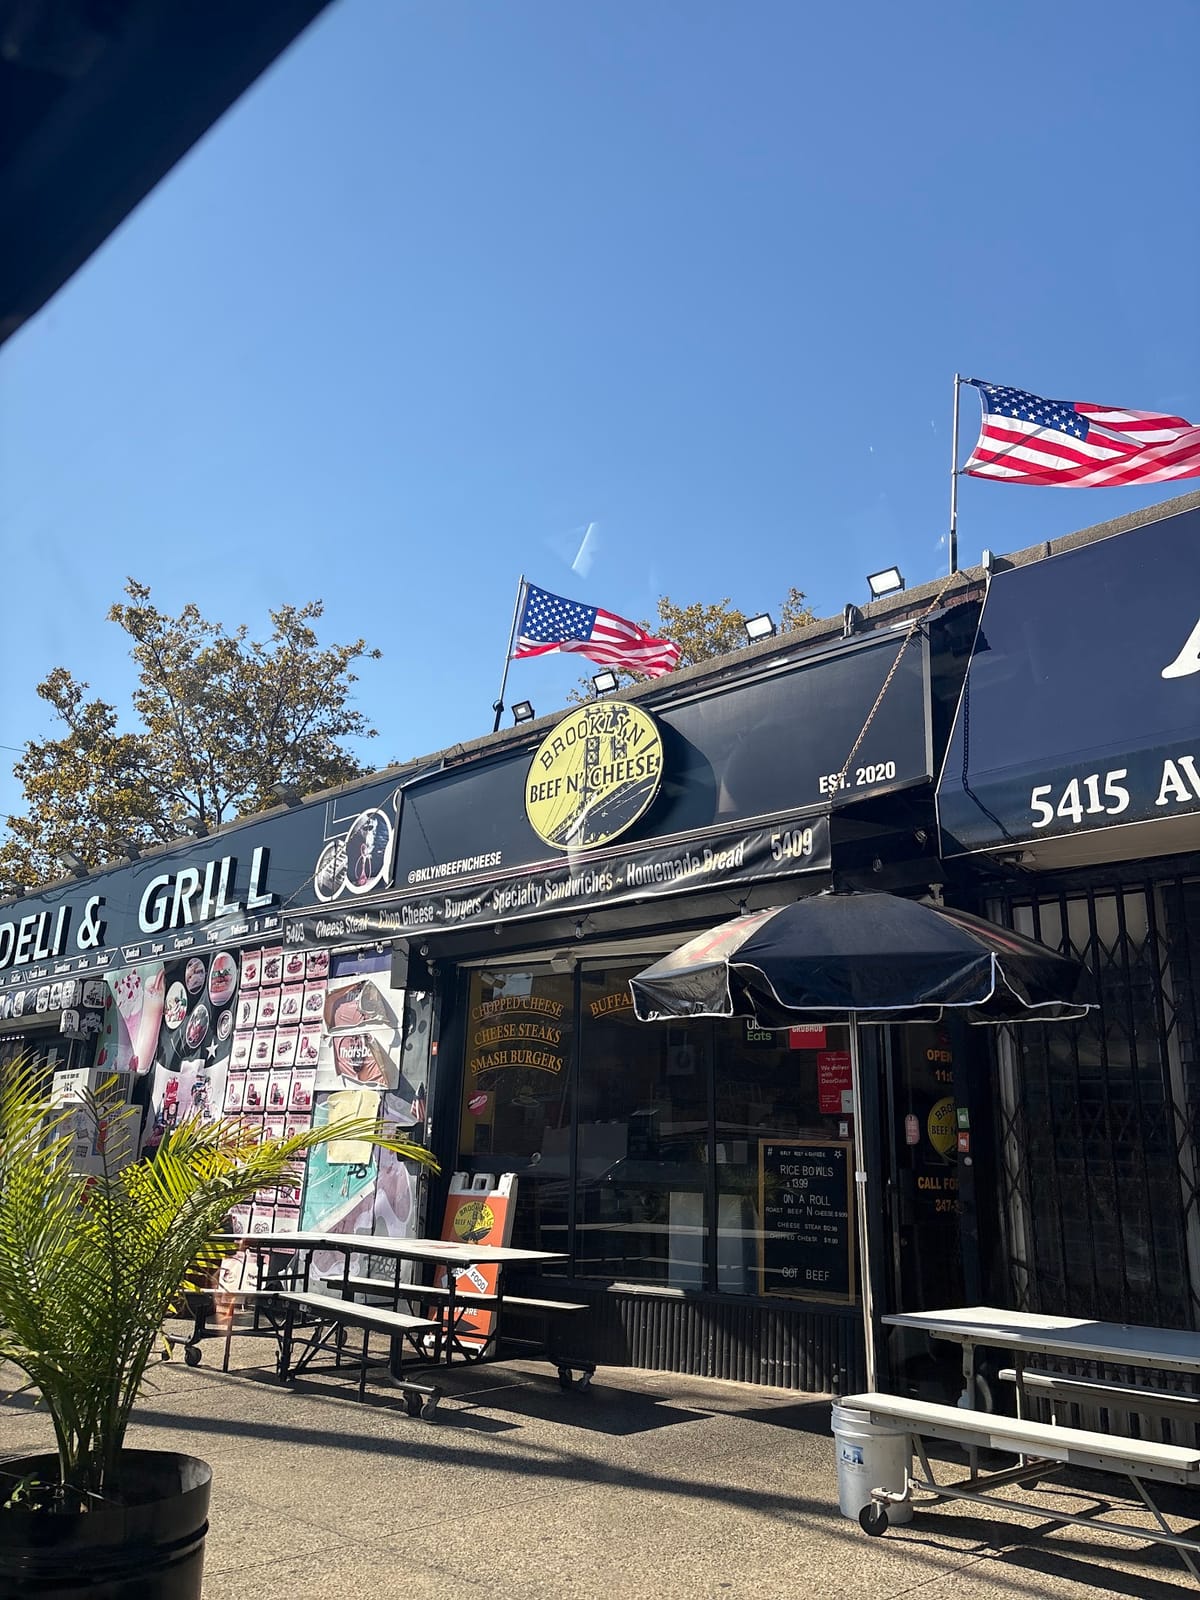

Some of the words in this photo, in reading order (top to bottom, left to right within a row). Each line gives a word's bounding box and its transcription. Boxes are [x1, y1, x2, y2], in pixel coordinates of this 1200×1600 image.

[540, 711, 646, 771] BROOKLYN
[529, 777, 562, 804] BEEF
[590, 753, 657, 787] CHEESE
[818, 771, 851, 794] EST.
[855, 760, 896, 786] 2020
[1030, 768, 1130, 829] 5415
[407, 851, 502, 884] @BKLYNBEEFNCHEESE
[138, 846, 274, 934] GRILL
[315, 919, 345, 939] Cheese
[345, 915, 369, 934] Steak
[378, 908, 400, 930] Chop
[402, 905, 434, 926] Cheese
[445, 896, 482, 920] Burgers
[493, 882, 542, 913] Specialty
[544, 871, 613, 900] Sandwiches
[626, 852, 700, 886] Homemade
[702, 844, 744, 873] Bread
[771, 828, 813, 861] 5409
[77, 895, 101, 950] &
[472, 998, 524, 1020] CHOPPED
[525, 997, 565, 1017] CHEESE
[474, 1023, 516, 1046] CHEESE
[518, 1023, 562, 1044] STEAKS
[747, 1030, 772, 1041] Eats
[471, 1050, 507, 1073] SMASH
[511, 1050, 564, 1072] BURGERS
[780, 1164, 800, 1176] RICE
[802, 1165, 834, 1177] BOWLS
[917, 1176, 942, 1191] CALL
[783, 1193, 794, 1205] ON
[798, 1194, 806, 1204] A
[810, 1194, 831, 1206] ROLL
[765, 1206, 783, 1214] ROAST
[806, 1205, 813, 1217] N
[814, 1210, 833, 1218] CHEESE
[777, 1221, 801, 1230] CHEESE
[797, 1235, 818, 1243] CHEESE
[470, 1270, 487, 1291] FOOD
[782, 1266, 798, 1279] GOT
[806, 1269, 830, 1281] BEEF
